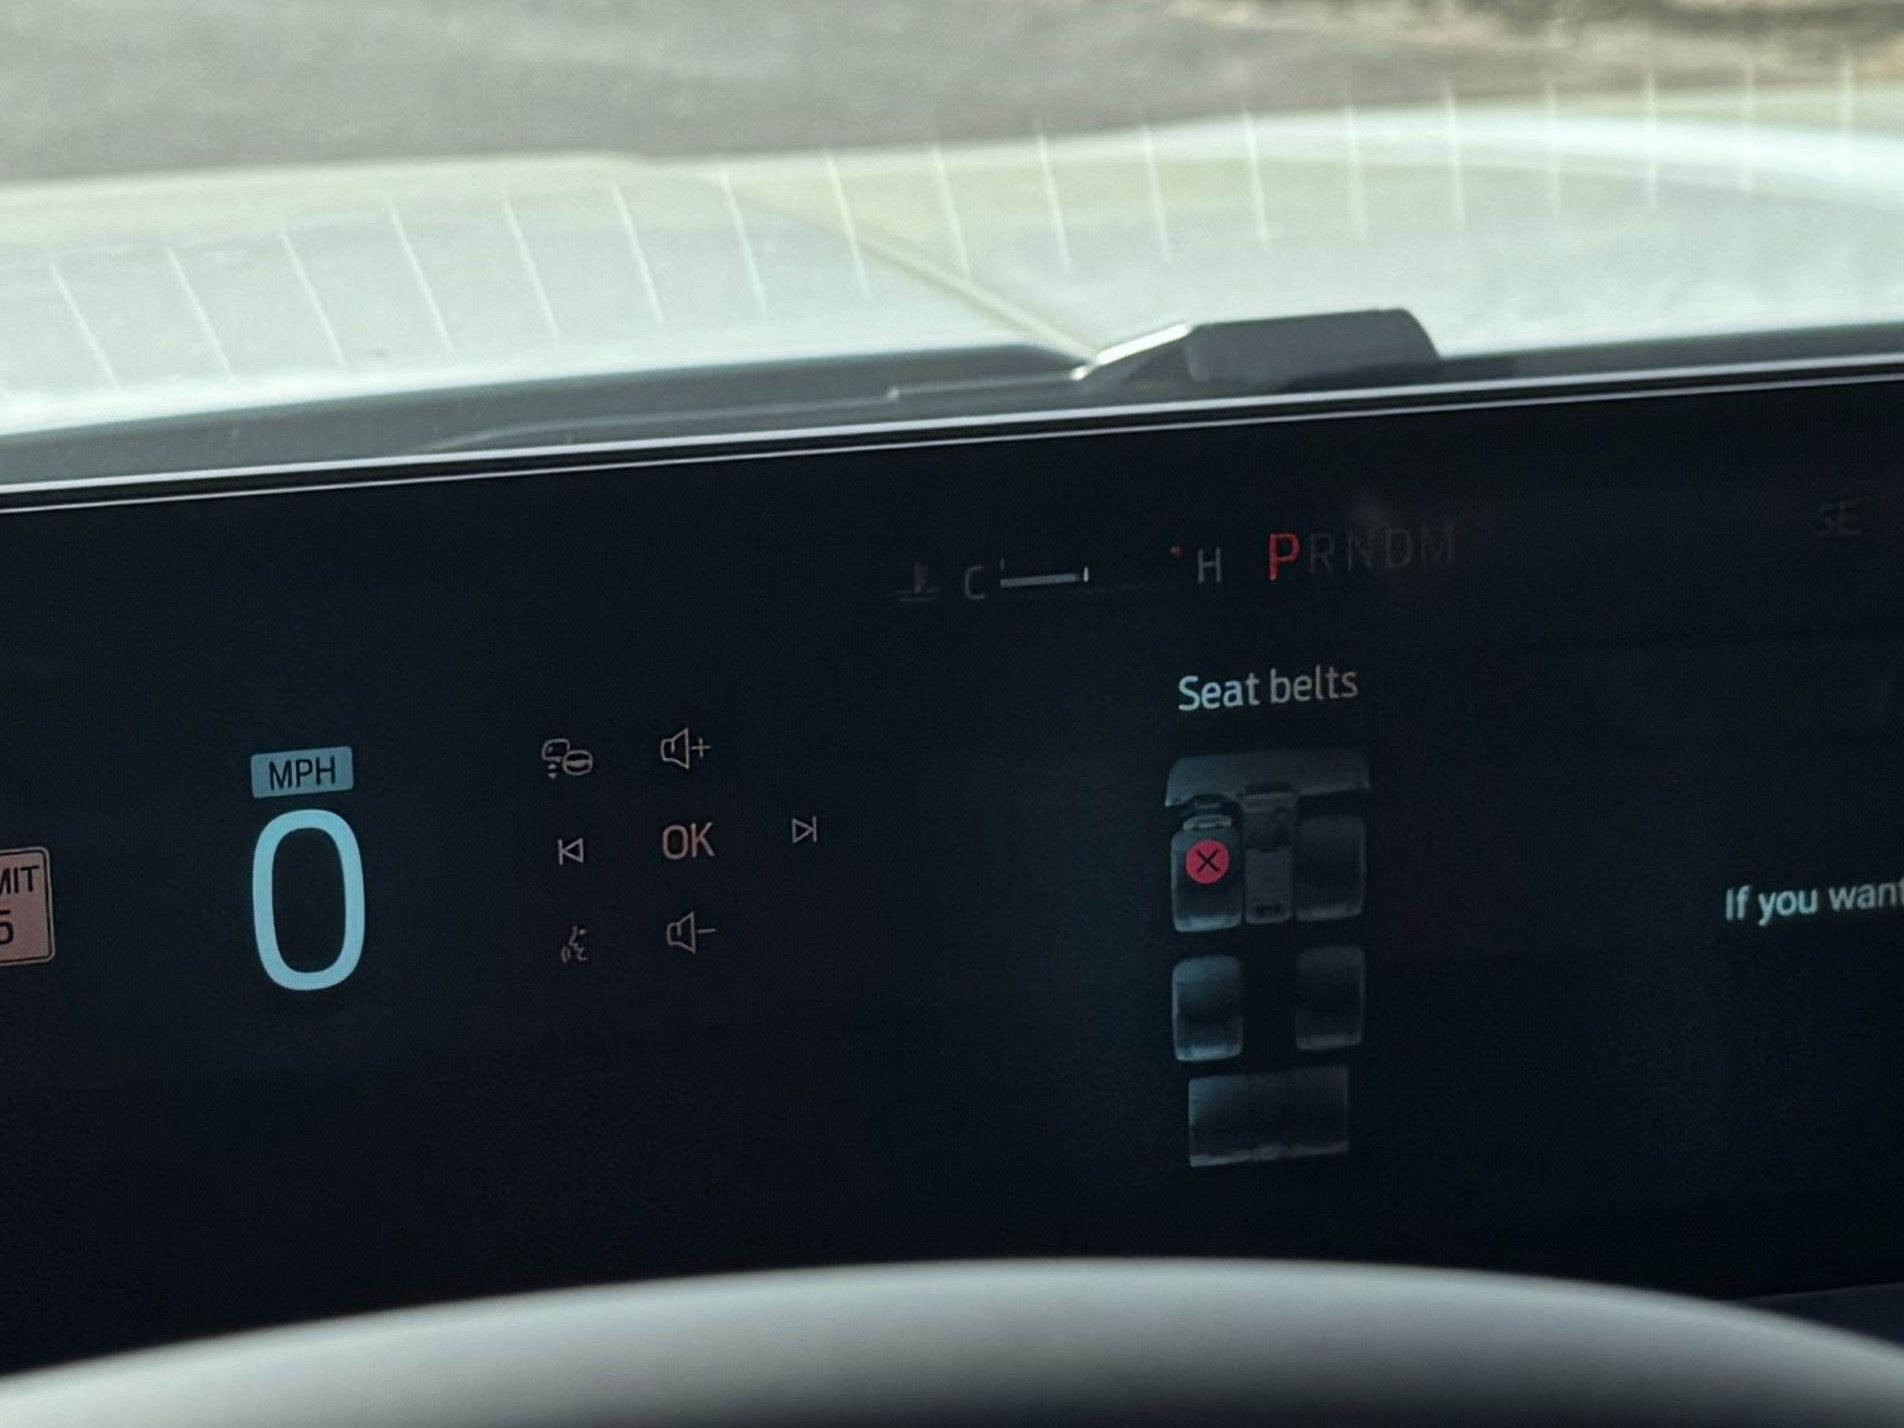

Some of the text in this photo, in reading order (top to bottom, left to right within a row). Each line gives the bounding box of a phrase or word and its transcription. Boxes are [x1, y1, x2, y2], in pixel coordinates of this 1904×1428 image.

[964, 566, 986, 601] C
[1197, 547, 1223, 584] H
[1178, 664, 1359, 712] Seat belts
[267, 756, 337, 790] MPH
[661, 820, 716, 861] OK
[249, 807, 366, 994] 0
[1724, 885, 1753, 921] If
[1758, 884, 1819, 928] you
